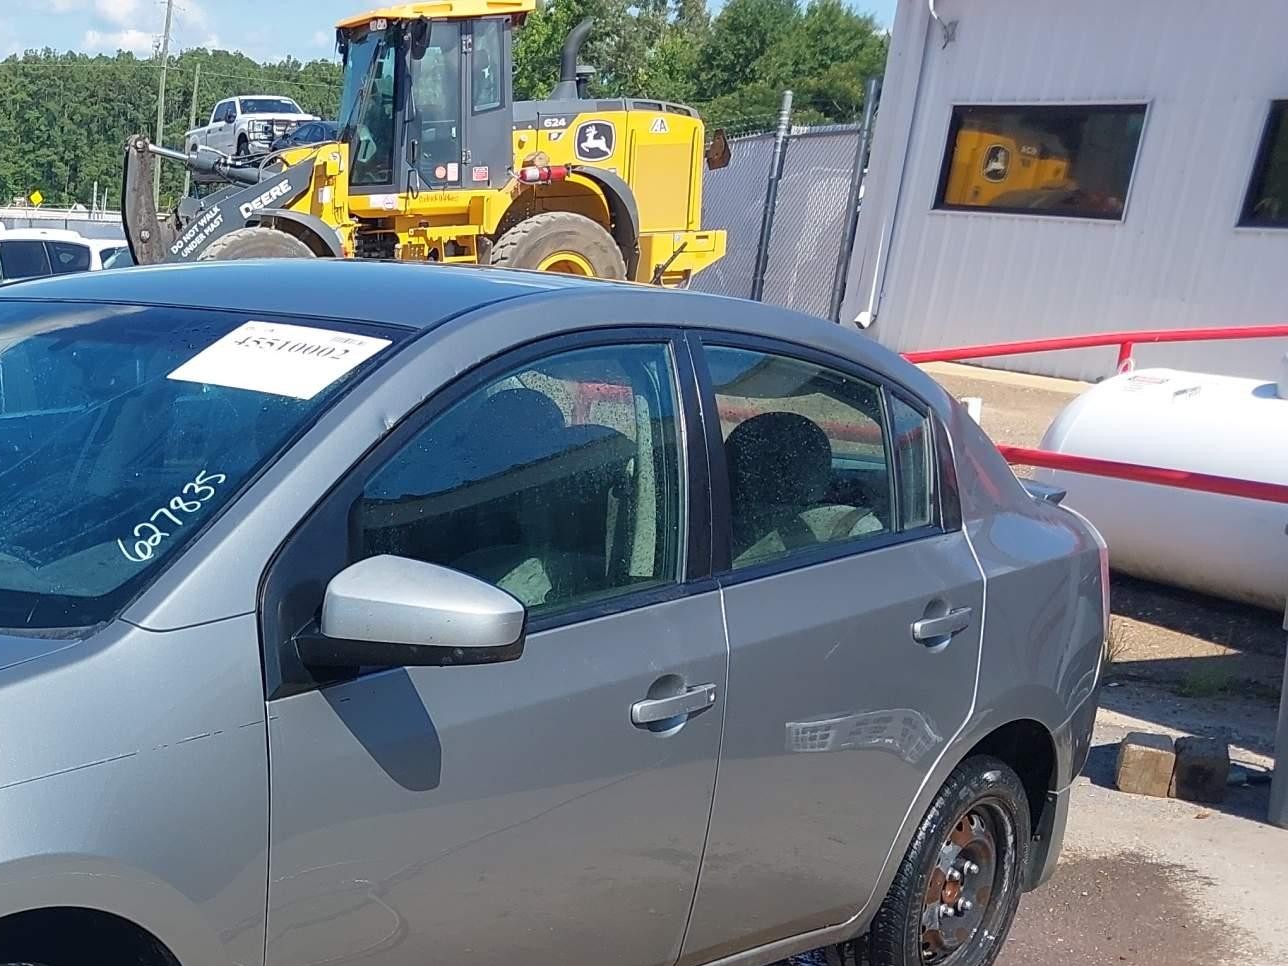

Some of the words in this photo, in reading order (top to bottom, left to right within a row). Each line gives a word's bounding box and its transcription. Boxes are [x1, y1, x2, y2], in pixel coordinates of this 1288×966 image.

[543, 117, 566, 128] 624
[239, 179, 292, 219] DEERE
[171, 240, 184, 255] DO
[182, 223, 199, 243] NOT
[198, 205, 221, 227] WALK
[181, 232, 207, 257] UNDER
[203, 214, 223, 236] MAST
[234, 335, 350, 361] 45510002
[117, 470, 226, 562] 627835
